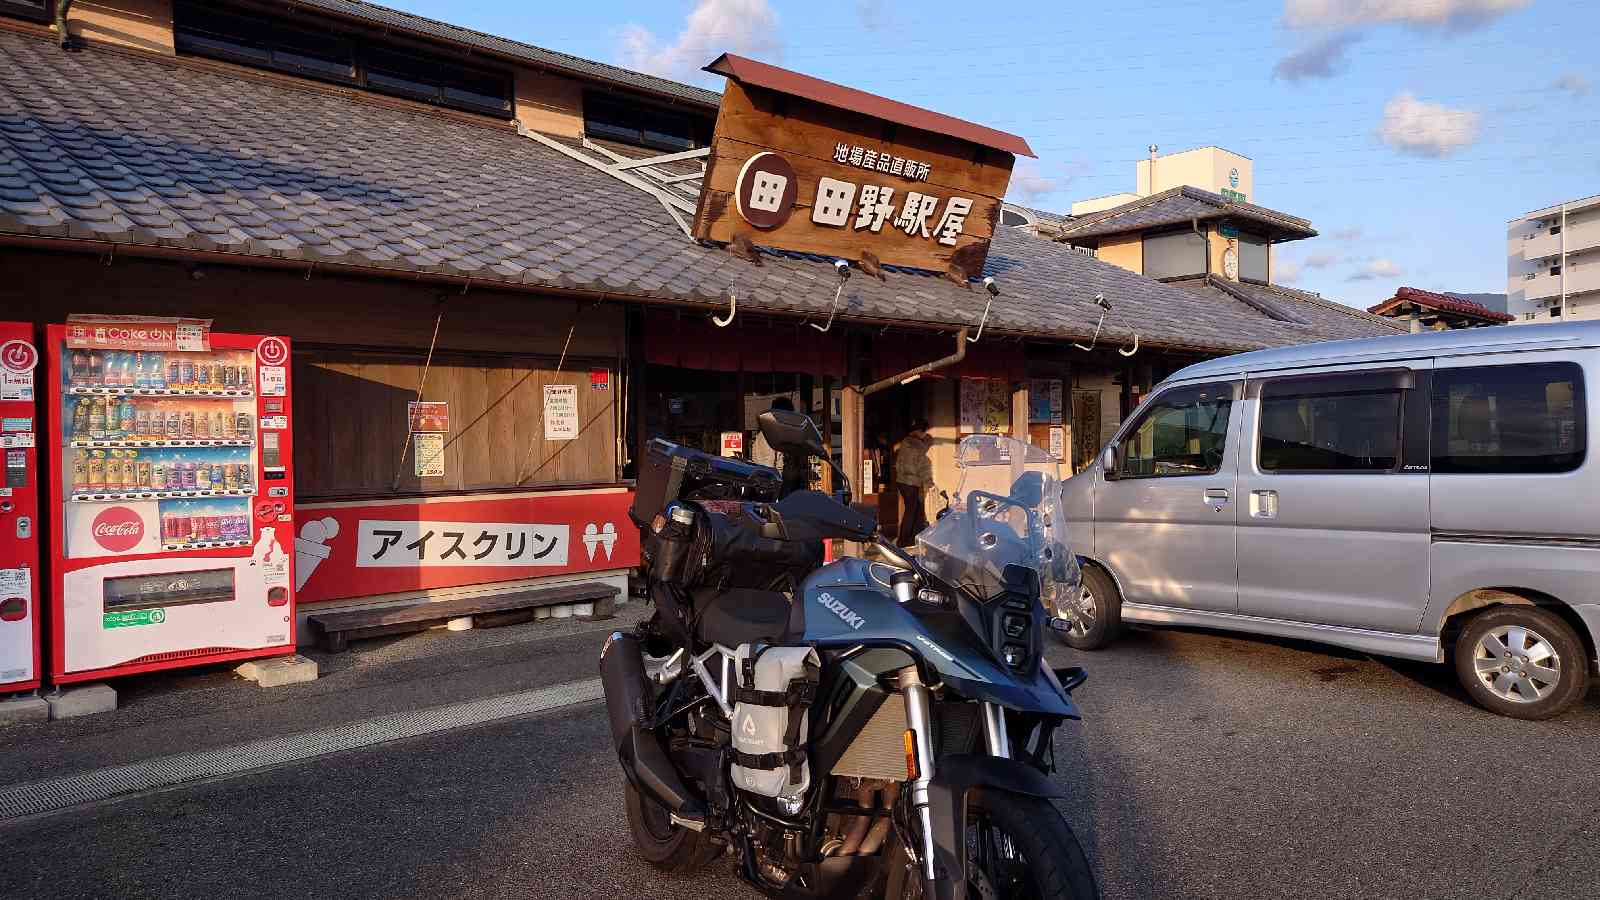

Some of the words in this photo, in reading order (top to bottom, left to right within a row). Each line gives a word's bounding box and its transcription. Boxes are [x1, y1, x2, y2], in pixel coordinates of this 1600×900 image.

[833, 143, 930, 181] 地場産品直販所
[812, 177, 973, 246] 田野駅屋
[108, 327, 146, 339] Coke
[94, 520, 139, 537] Coca-Cola
[371, 529, 558, 560] アイスクリン
[817, 592, 865, 630] SUZUKI
